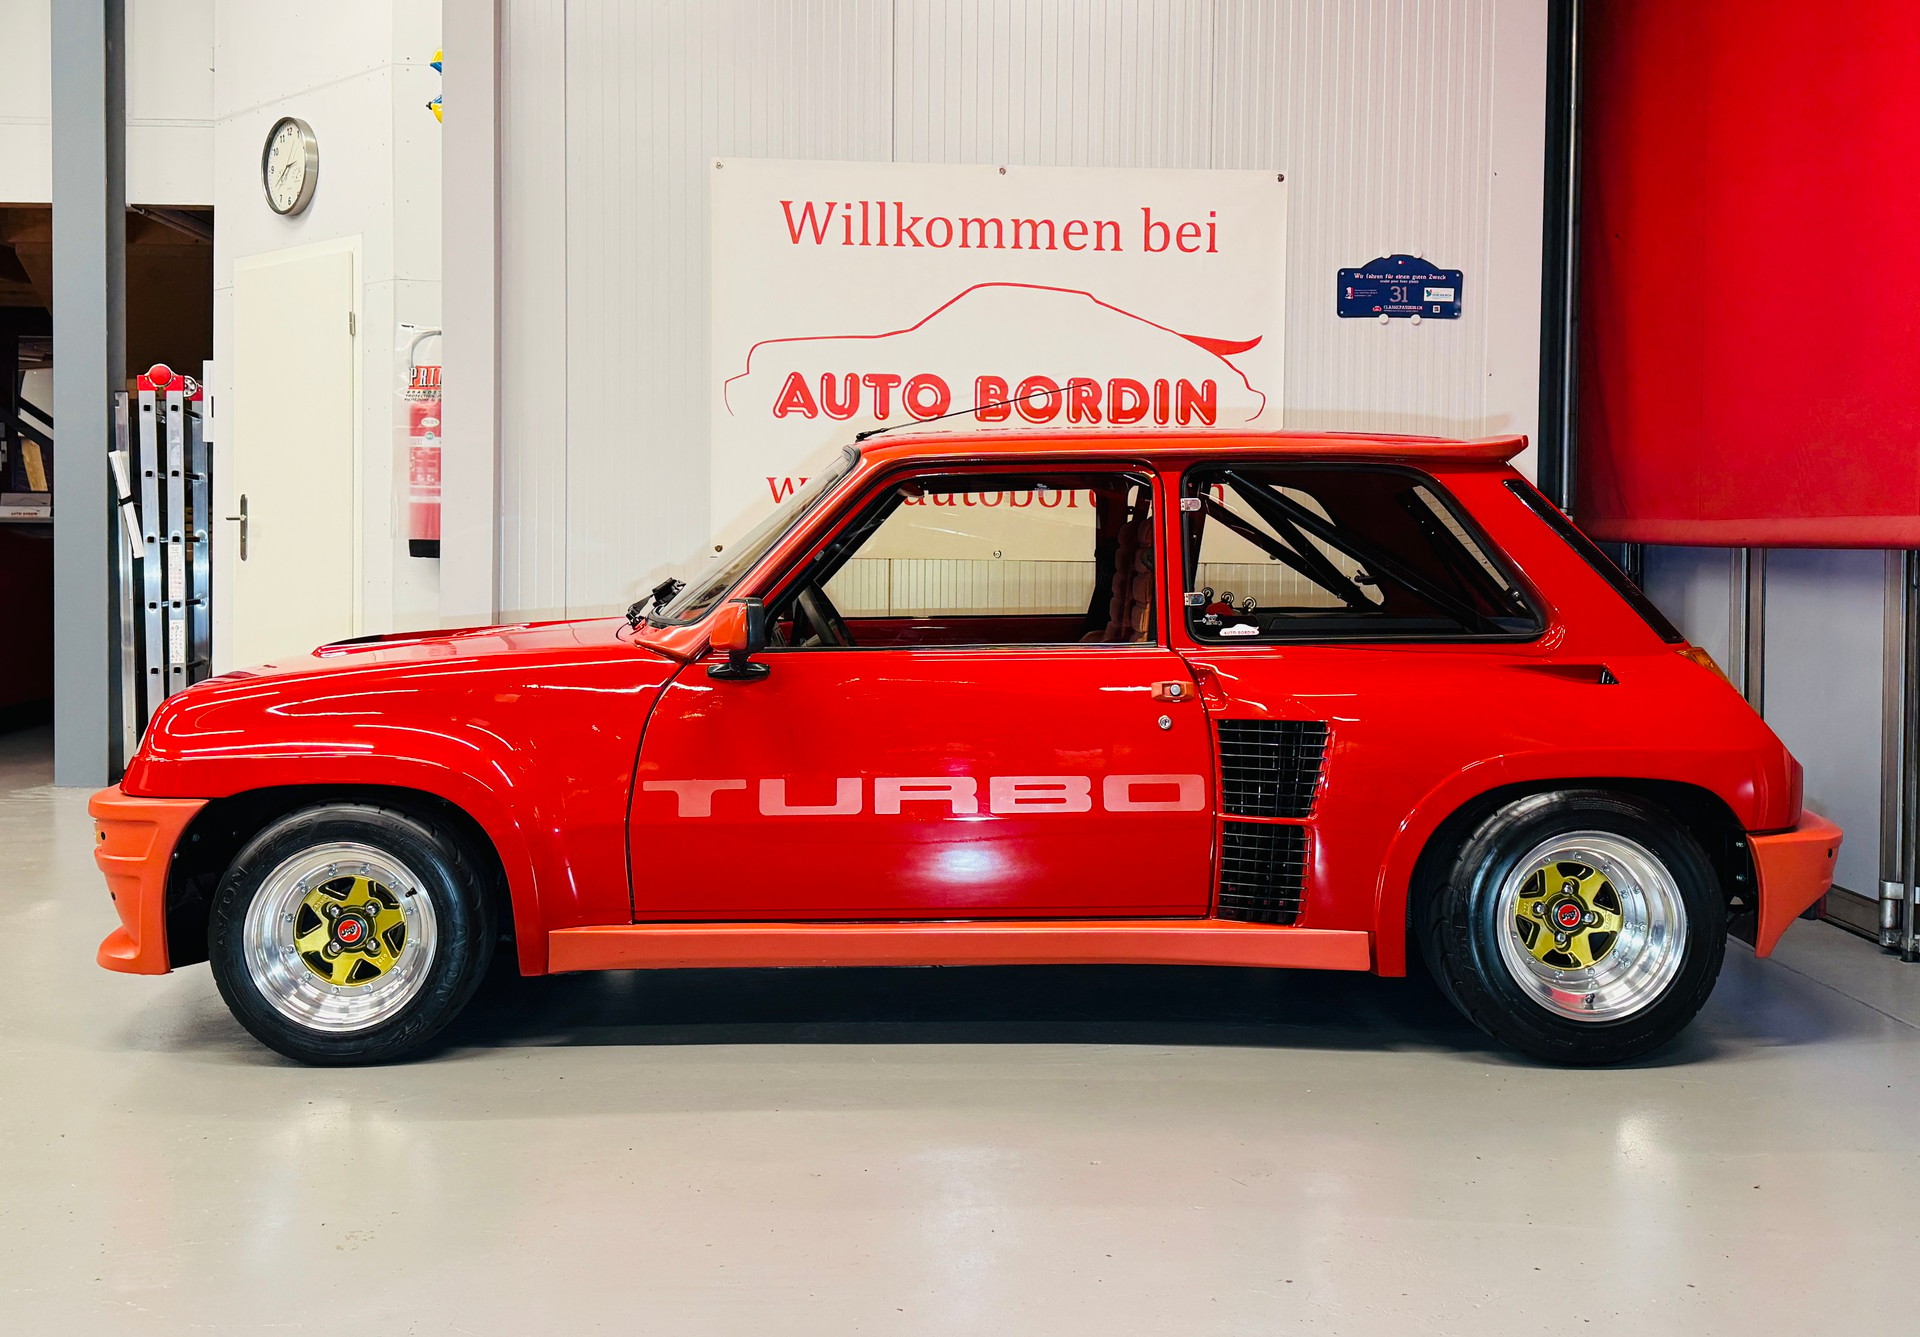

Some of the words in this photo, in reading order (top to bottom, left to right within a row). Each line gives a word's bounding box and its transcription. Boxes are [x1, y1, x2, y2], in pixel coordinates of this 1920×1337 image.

[279, 135, 286, 144] 11
[286, 127, 293, 136] 12
[273, 147, 279, 157] 10
[270, 165, 275, 175] 9
[287, 196, 292, 206] 6
[779, 200, 1123, 252] Willkommen
[1142, 207, 1219, 253] bei
[1389, 286, 1408, 303] 31
[408, 367, 441, 388] PRI
[772, 371, 951, 421] AUTO
[974, 375, 1217, 425] BORDIN
[643, 773, 1205, 818] TURBO
[217, 866, 249, 949] AVON
[435, 920, 468, 1008] AVON
